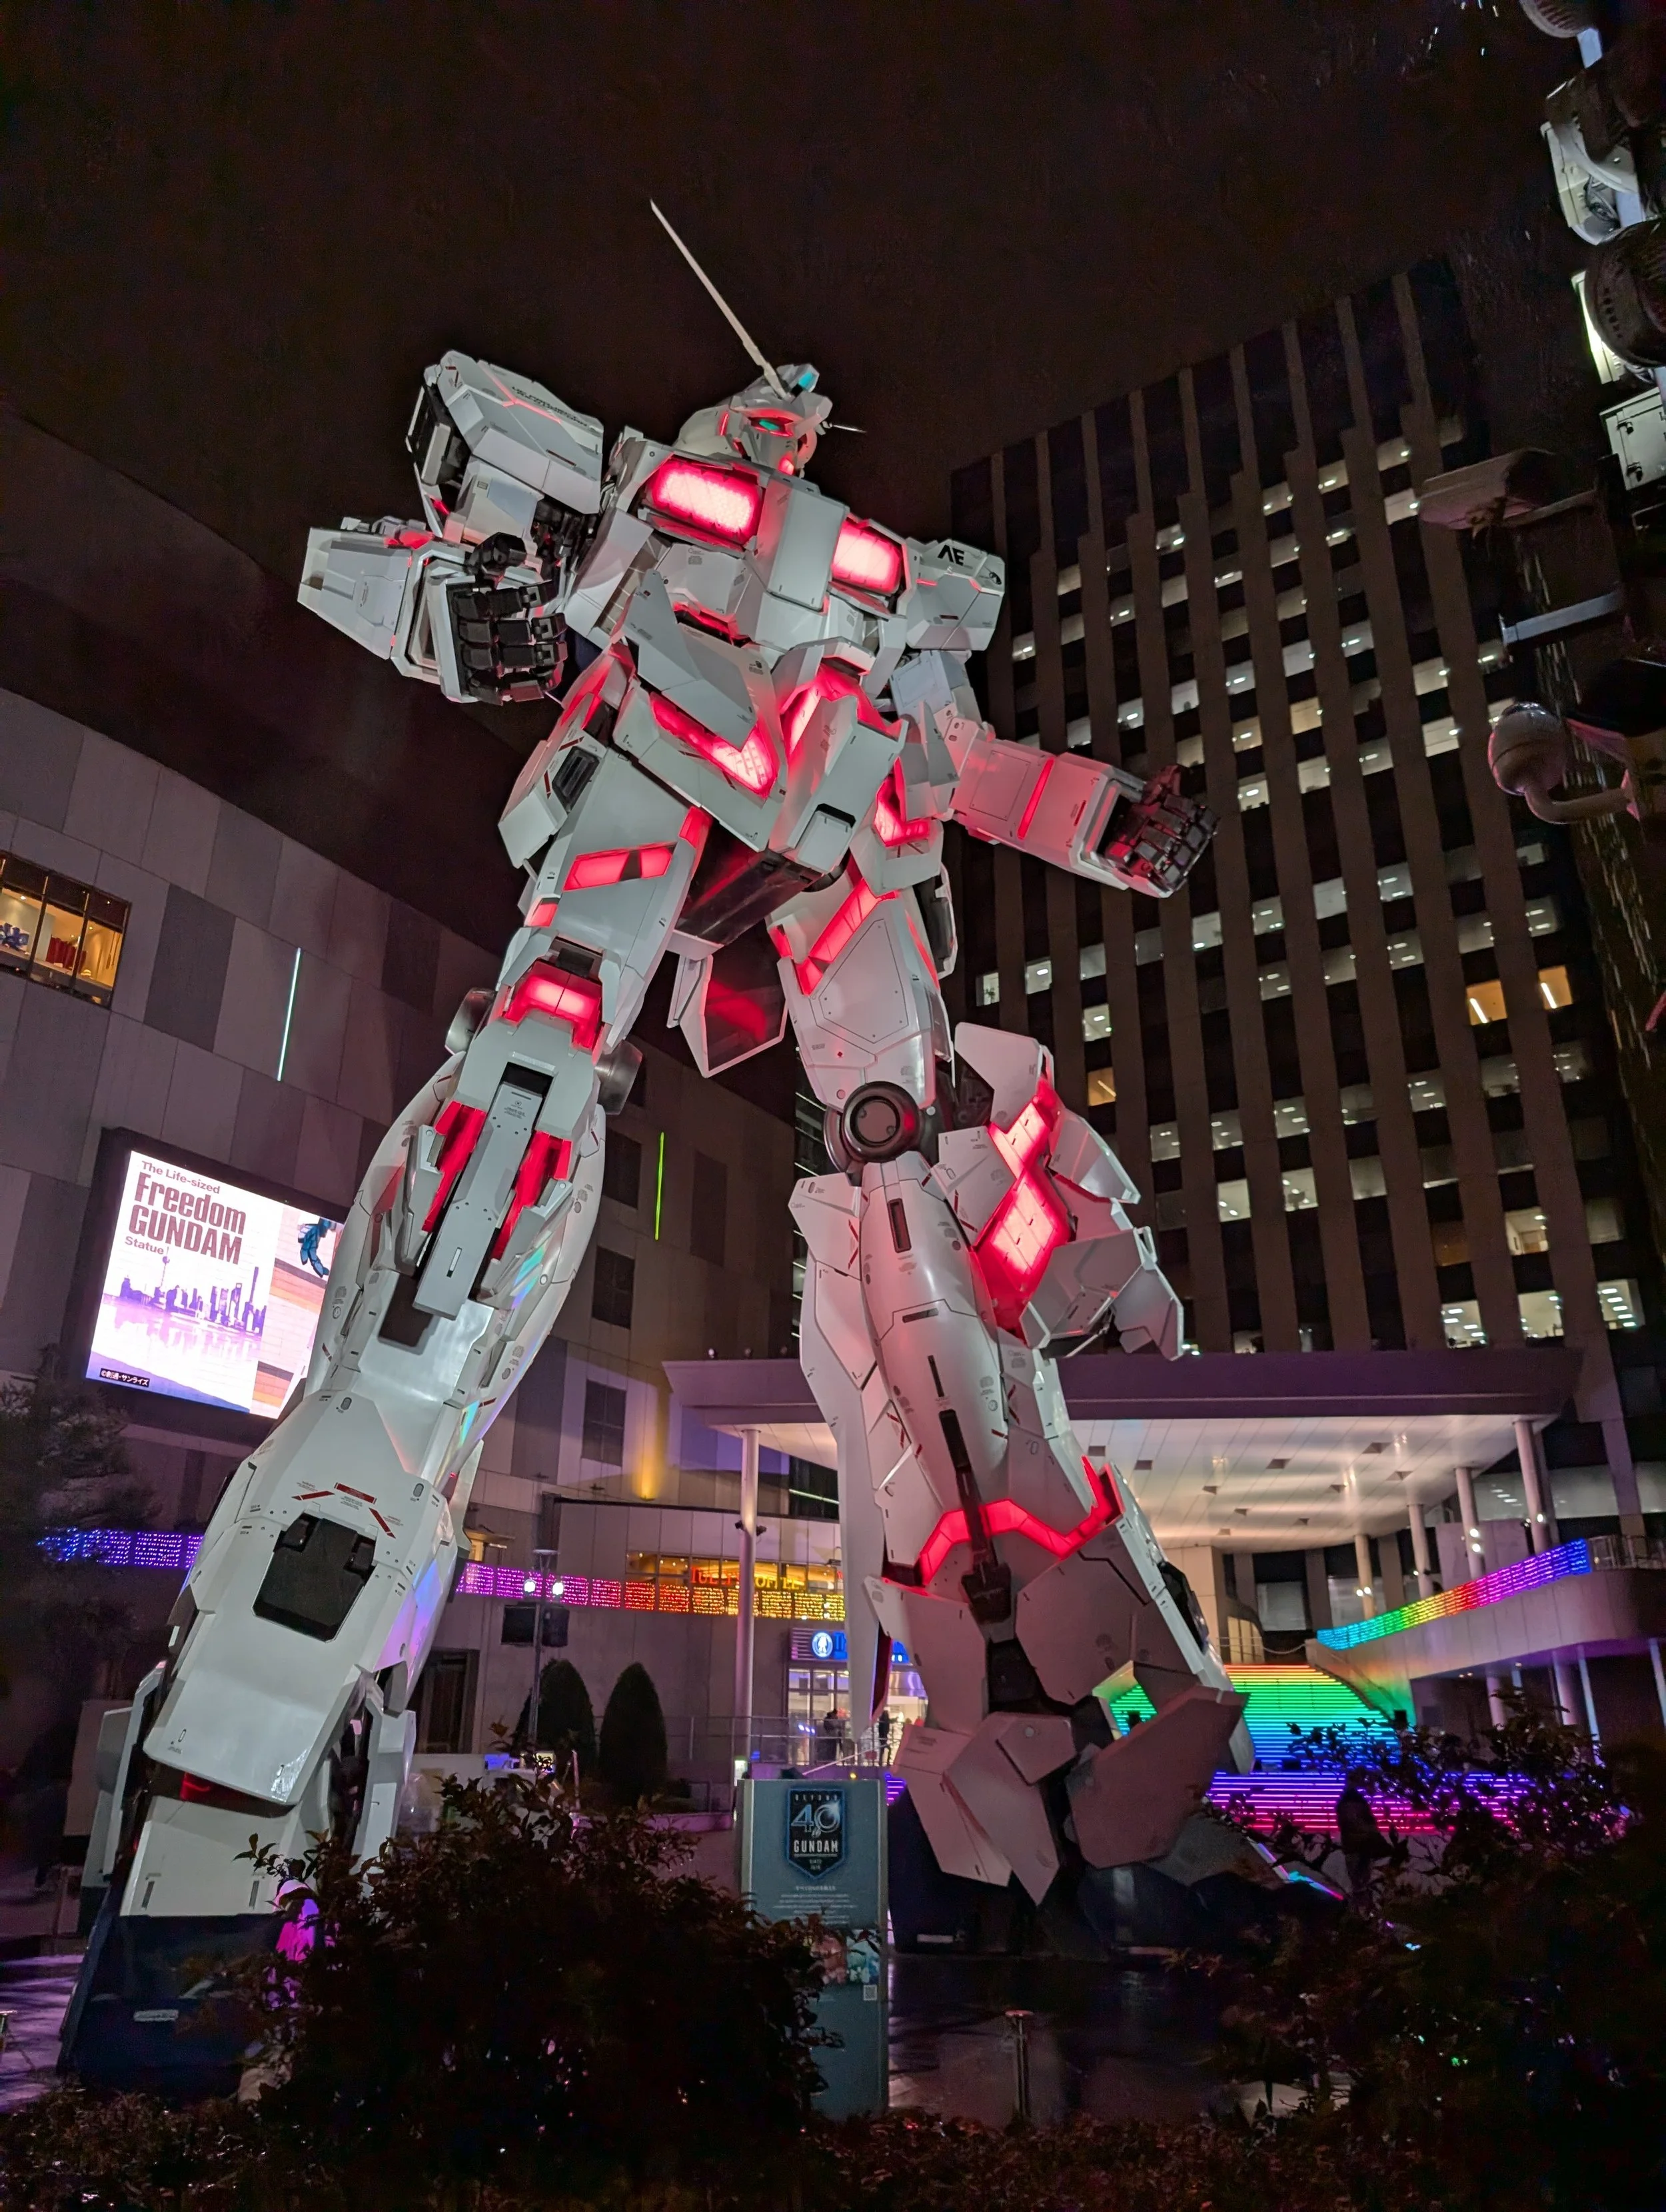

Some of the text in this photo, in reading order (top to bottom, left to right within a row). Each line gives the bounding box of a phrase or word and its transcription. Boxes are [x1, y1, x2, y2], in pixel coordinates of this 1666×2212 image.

[141, 1160, 221, 1194] The Life-sized
[134, 1171, 247, 1235] Freedom
[125, 1236, 164, 1255] Statue
[129, 1204, 243, 1265] GUNDAM
[793, 1840, 838, 1853] GUNDAM
